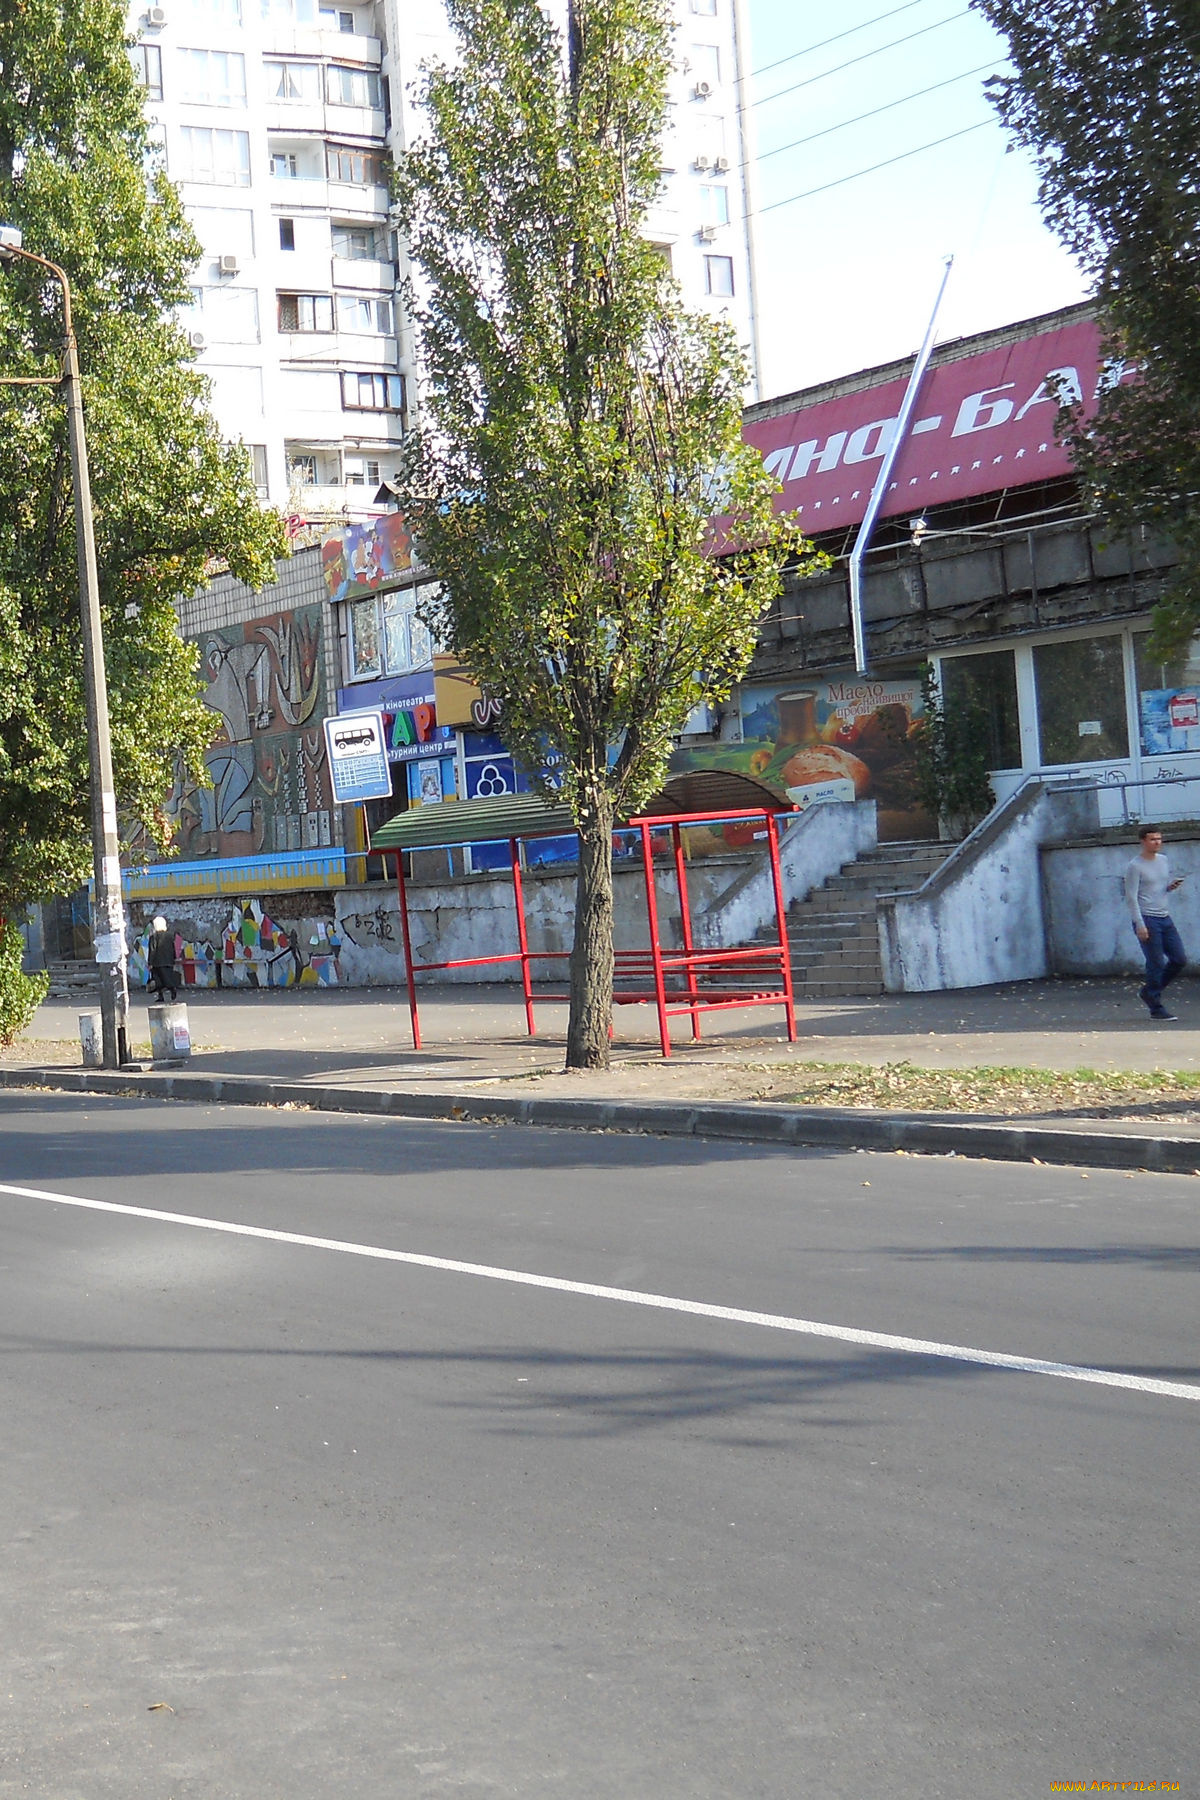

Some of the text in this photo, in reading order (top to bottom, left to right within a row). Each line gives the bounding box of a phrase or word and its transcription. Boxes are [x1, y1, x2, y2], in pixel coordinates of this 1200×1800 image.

[827, 682, 884, 702] Масло
[385, 696, 424, 710] кінотеатр
[386, 744, 418, 760] ьтурний
[419, 742, 443, 755] центр
